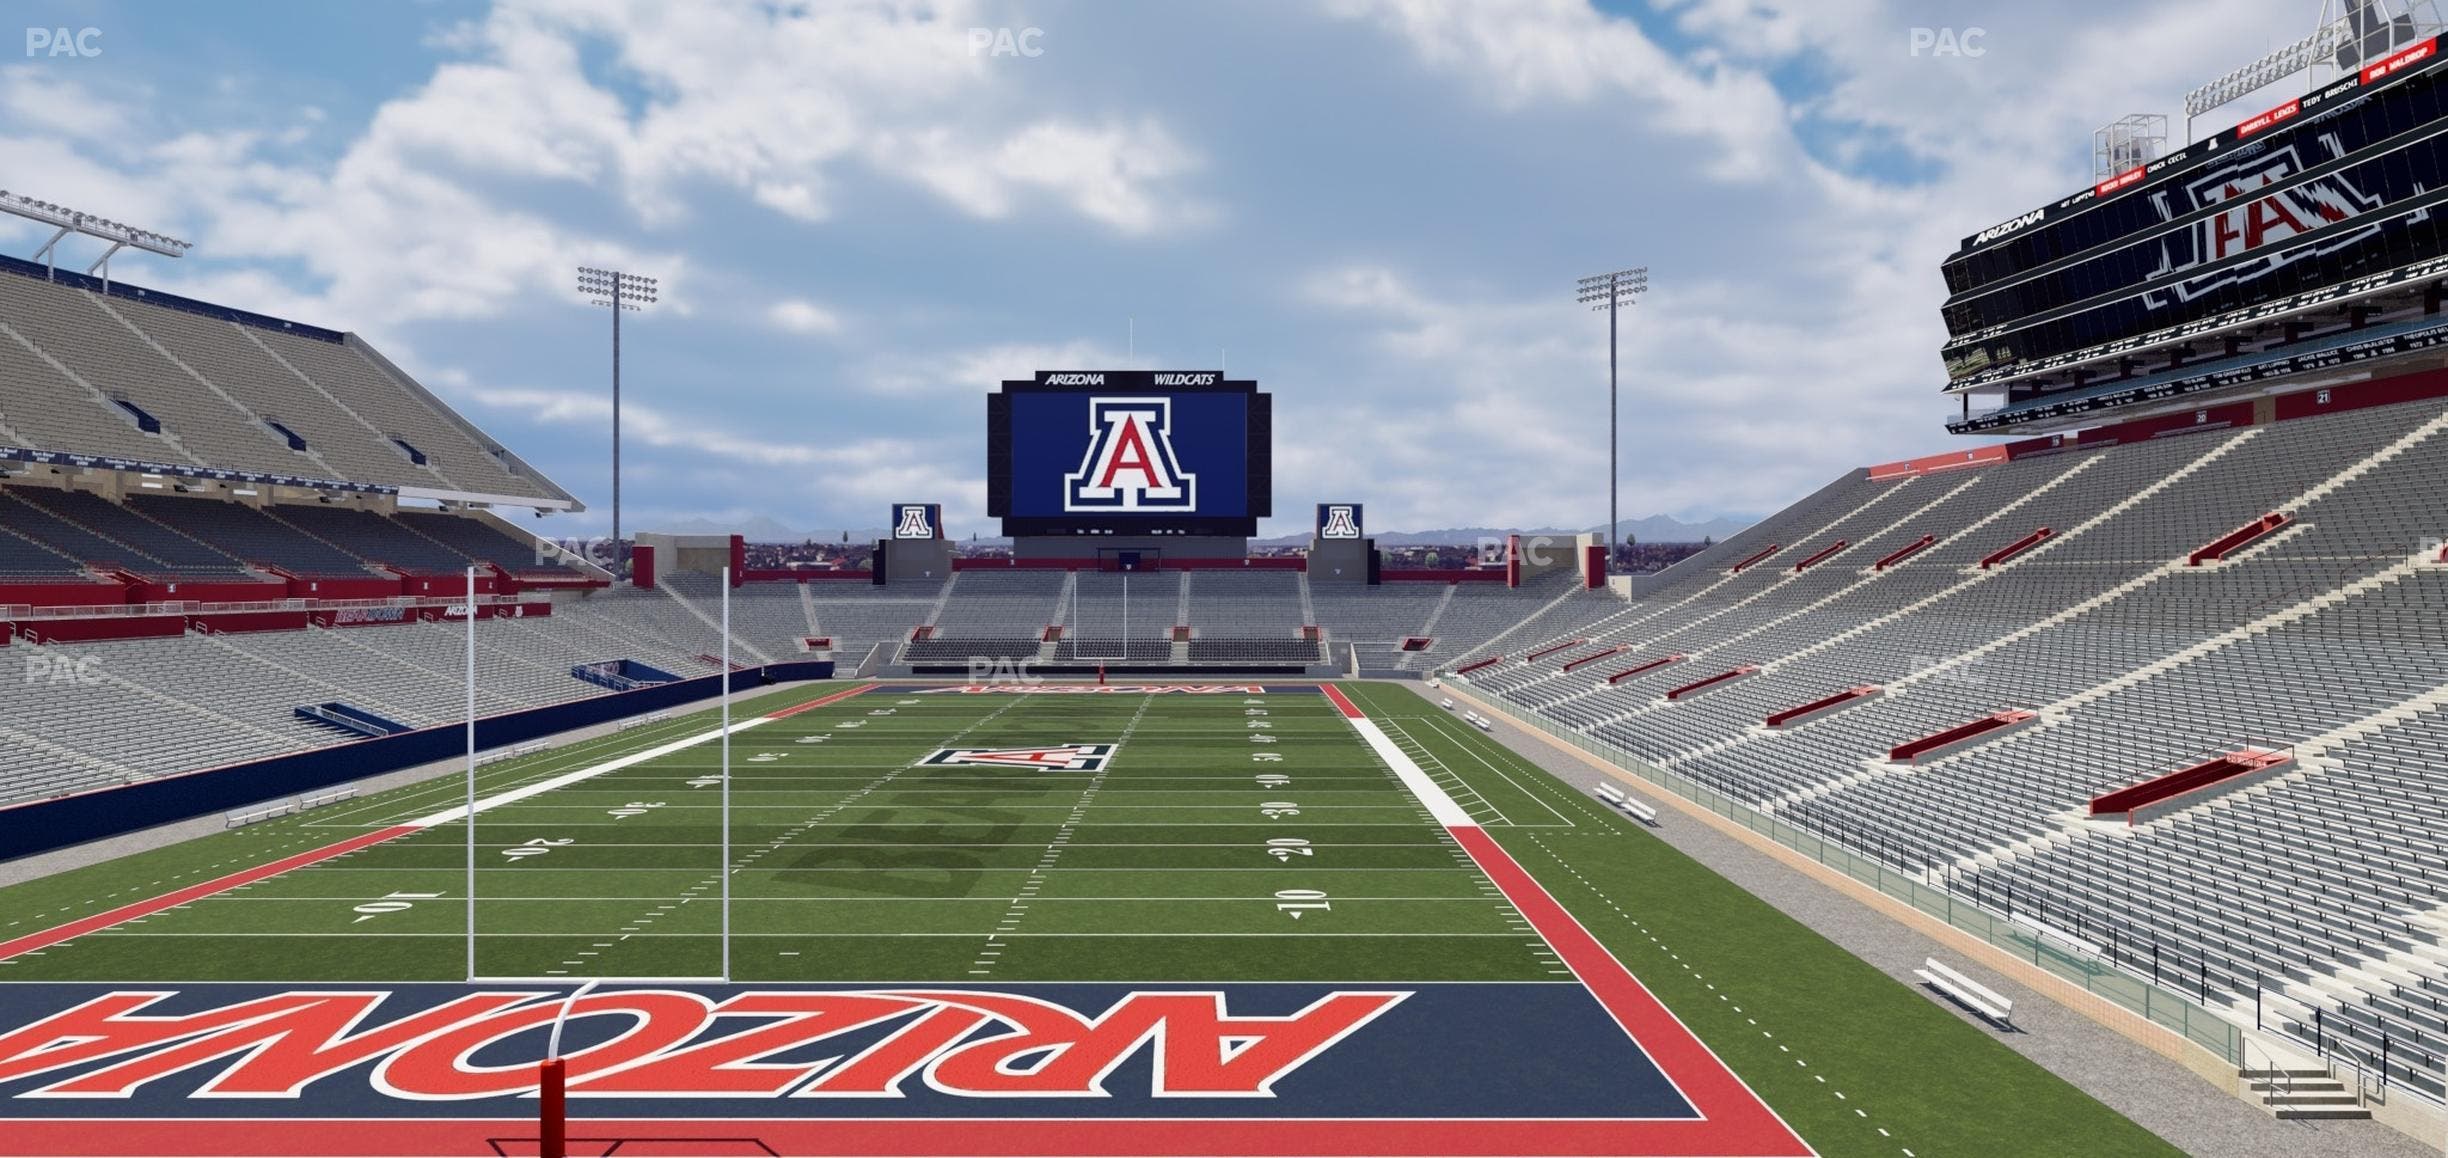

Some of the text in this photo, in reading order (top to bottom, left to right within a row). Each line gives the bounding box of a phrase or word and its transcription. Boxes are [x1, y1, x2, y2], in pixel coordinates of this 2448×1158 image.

[2302, 78, 2358, 109] TEDY BRUSCHI
[1972, 209, 2045, 246] ARIZONA
[1045, 374, 1215, 385] ARIZONA WILDCATS
[1064, 397, 1196, 512] A
[895, 505, 932, 539] A
[1322, 505, 1360, 539] A
[1260, 802, 1300, 815] 30
[502, 838, 574, 856] 20
[1266, 838, 1313, 856] 20
[352, 890, 447, 913] 10
[1275, 889, 1331, 911] 10
[0, 990, 1417, 1100] ARIZONA
